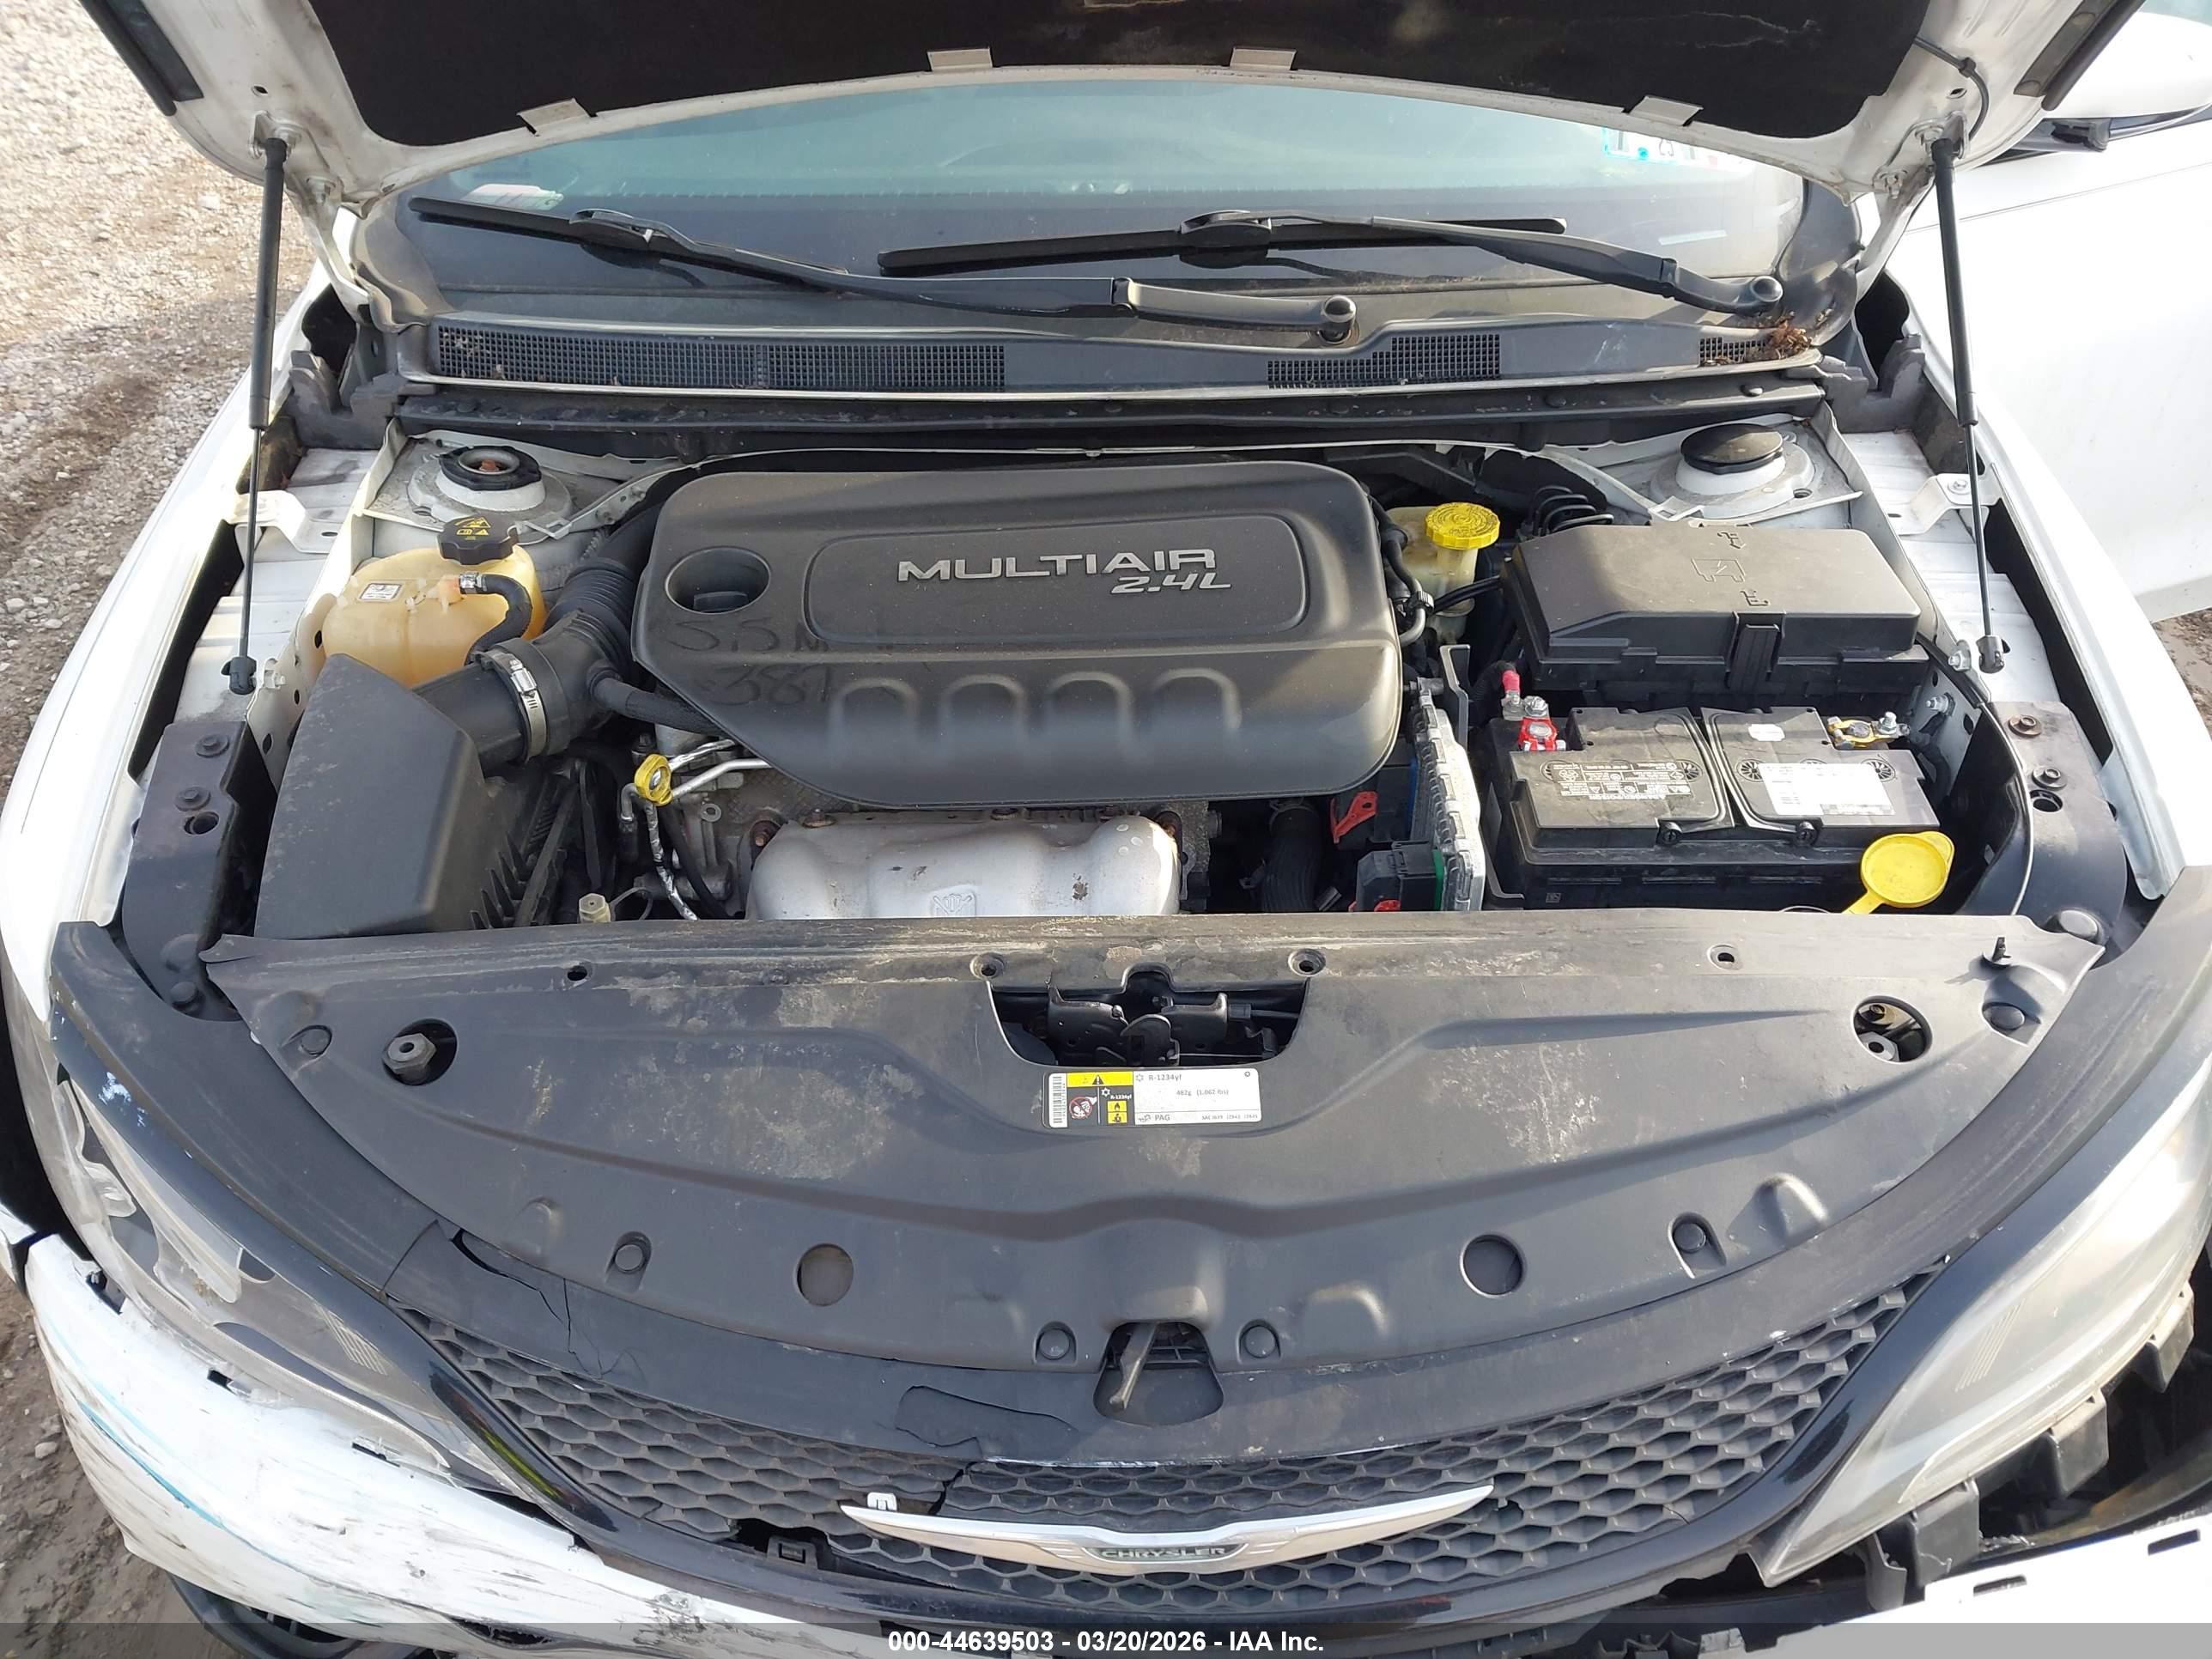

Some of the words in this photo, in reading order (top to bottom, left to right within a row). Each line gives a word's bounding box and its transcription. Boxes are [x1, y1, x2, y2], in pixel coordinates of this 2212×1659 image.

[897, 548, 1217, 581] MULTIAIR
[1110, 572, 1232, 594] 2.4L
[1148, 1073, 1182, 1082] R-1234yf
[1101, 1547, 1225, 1559] CHRYSLER
